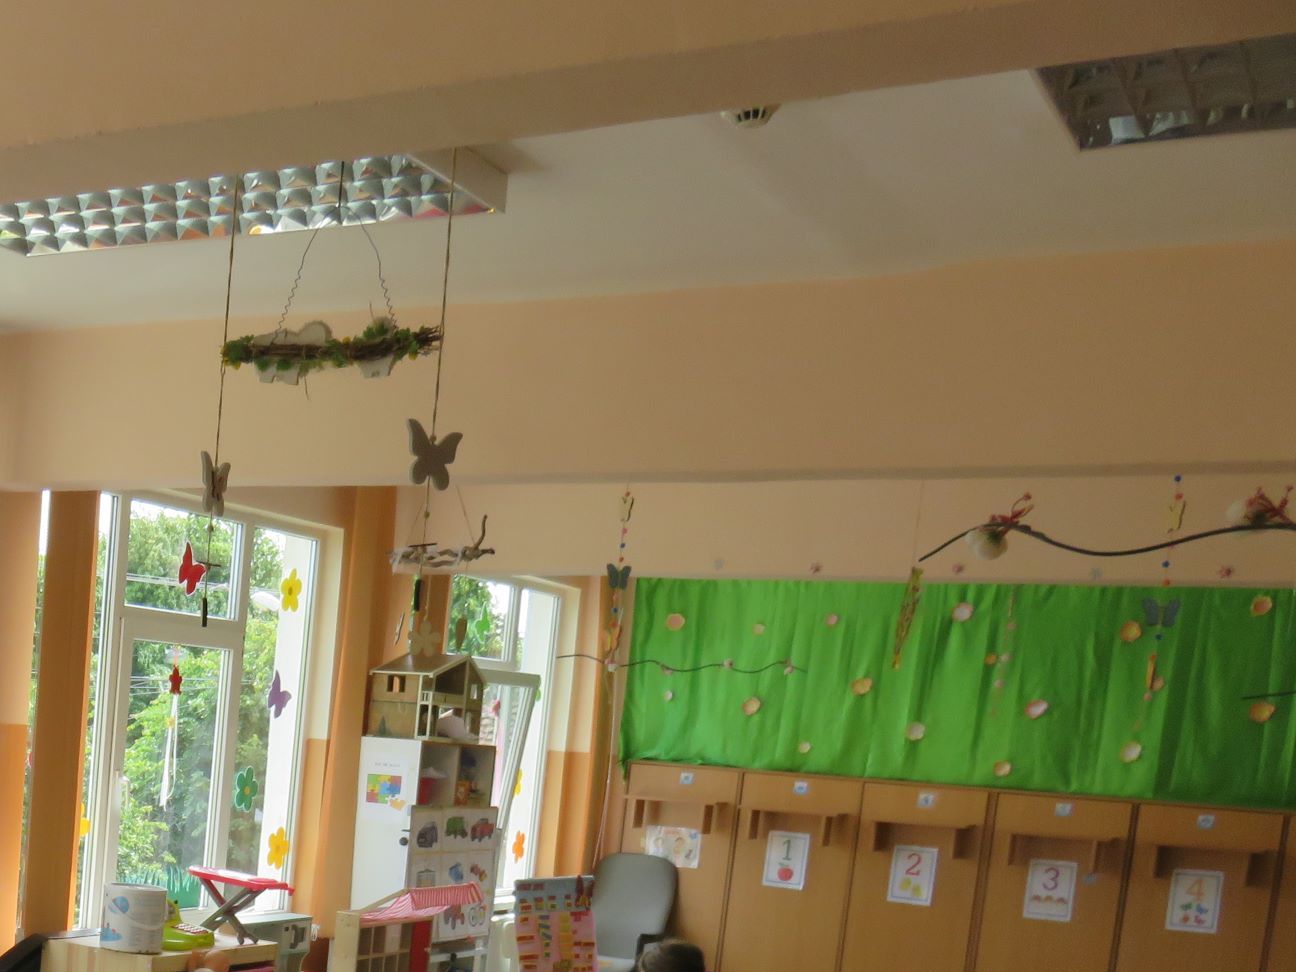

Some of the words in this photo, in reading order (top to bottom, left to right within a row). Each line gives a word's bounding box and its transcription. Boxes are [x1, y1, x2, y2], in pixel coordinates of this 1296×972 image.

[782, 838, 793, 861] 1
[904, 852, 922, 877] 2
[1041, 866, 1061, 891] 3
[1185, 877, 1207, 902] 4
